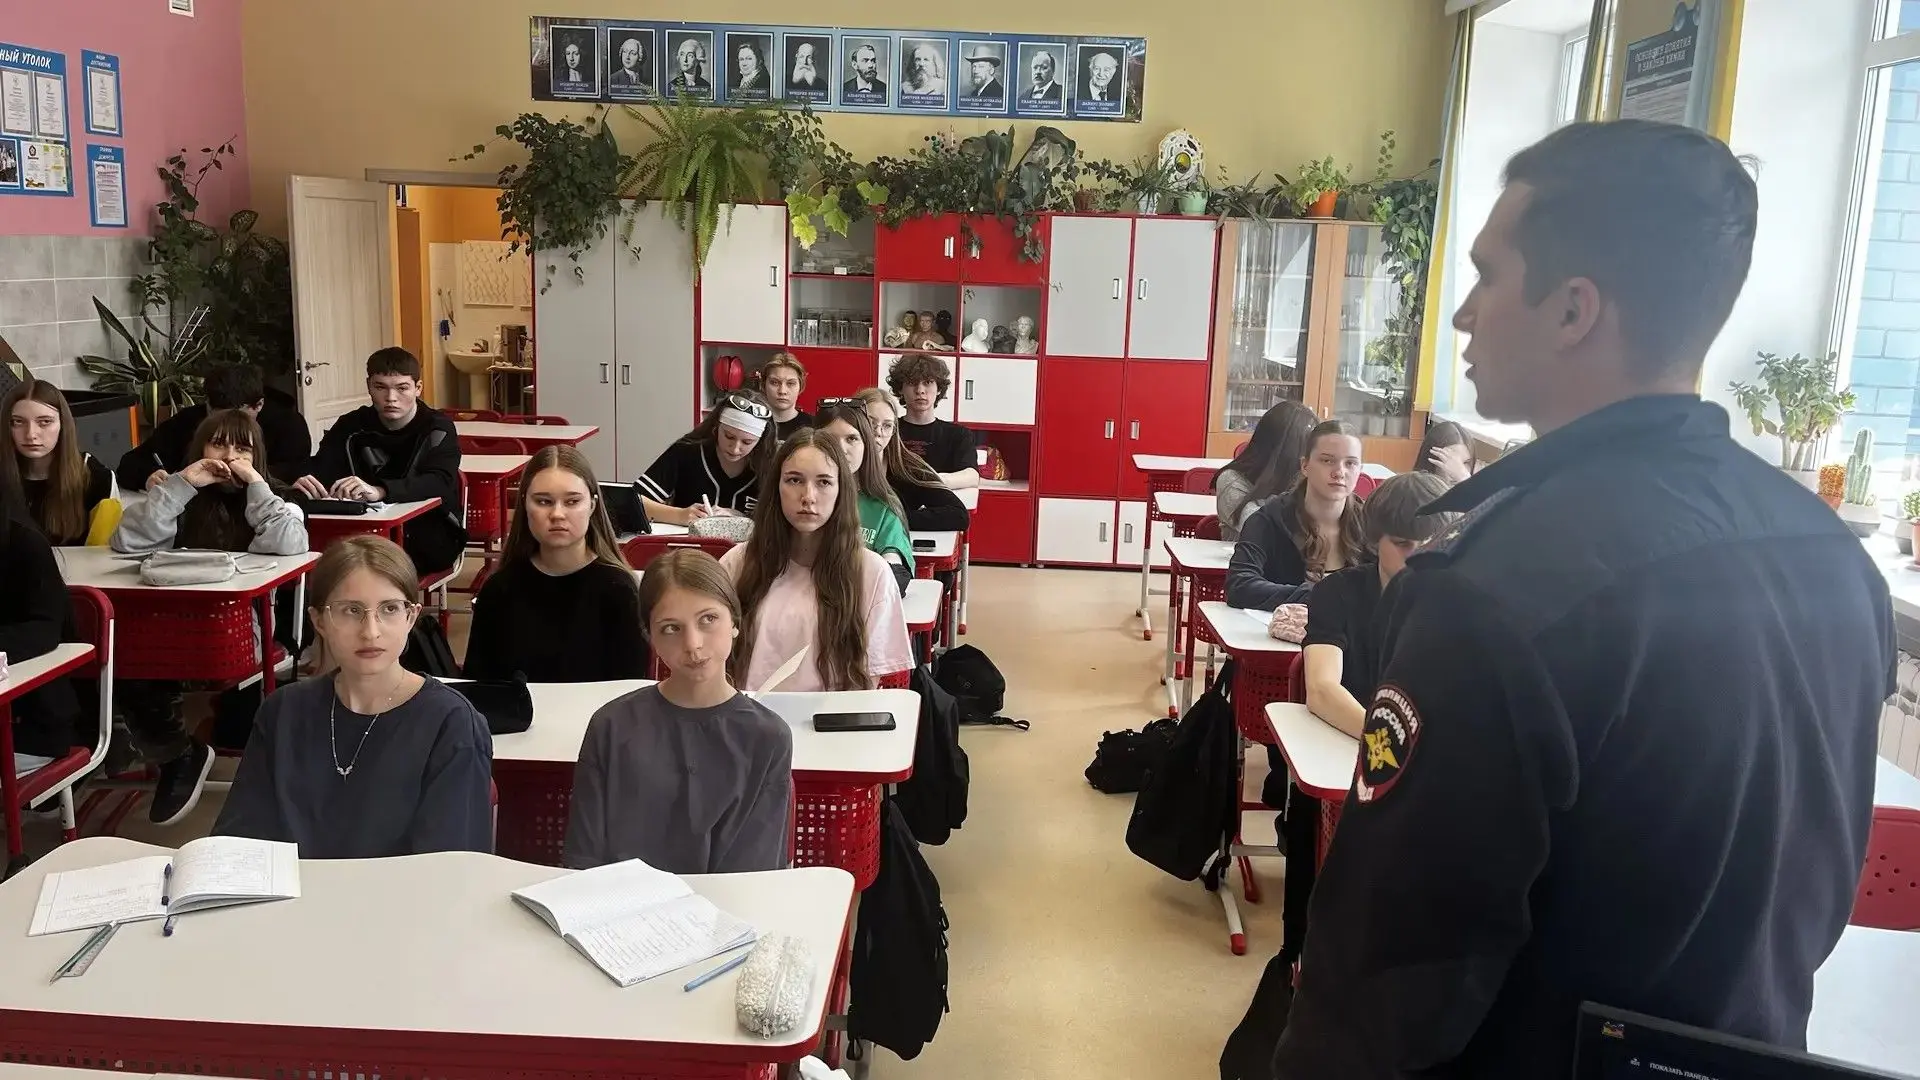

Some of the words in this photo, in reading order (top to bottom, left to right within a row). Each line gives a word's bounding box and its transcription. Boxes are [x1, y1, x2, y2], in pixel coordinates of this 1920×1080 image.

[1372, 707, 1406, 746] РОССИЯ
[1375, 688, 1419, 735] ПОЛИЦИЯ
[1649, 1062, 1683, 1076] ПОКАЗАТЬ
[1683, 1071, 1711, 1080] ПАНЕЛЬ
